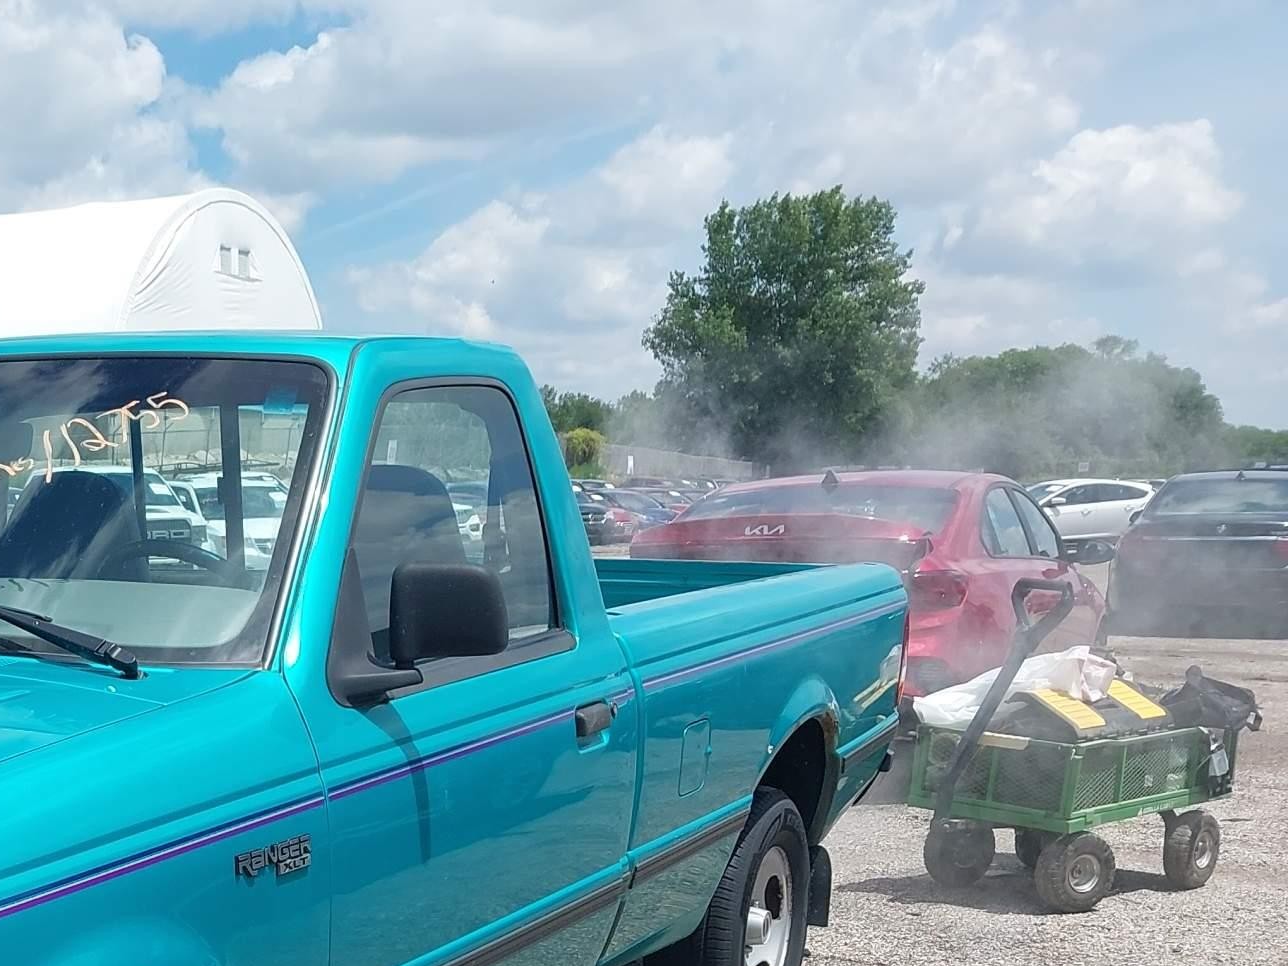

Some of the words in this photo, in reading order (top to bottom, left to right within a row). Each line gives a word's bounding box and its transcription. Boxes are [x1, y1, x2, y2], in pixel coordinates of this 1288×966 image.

[744, 524, 785, 536] KIA
[235, 832, 312, 876] RANGER
[282, 856, 309, 873] XLT
